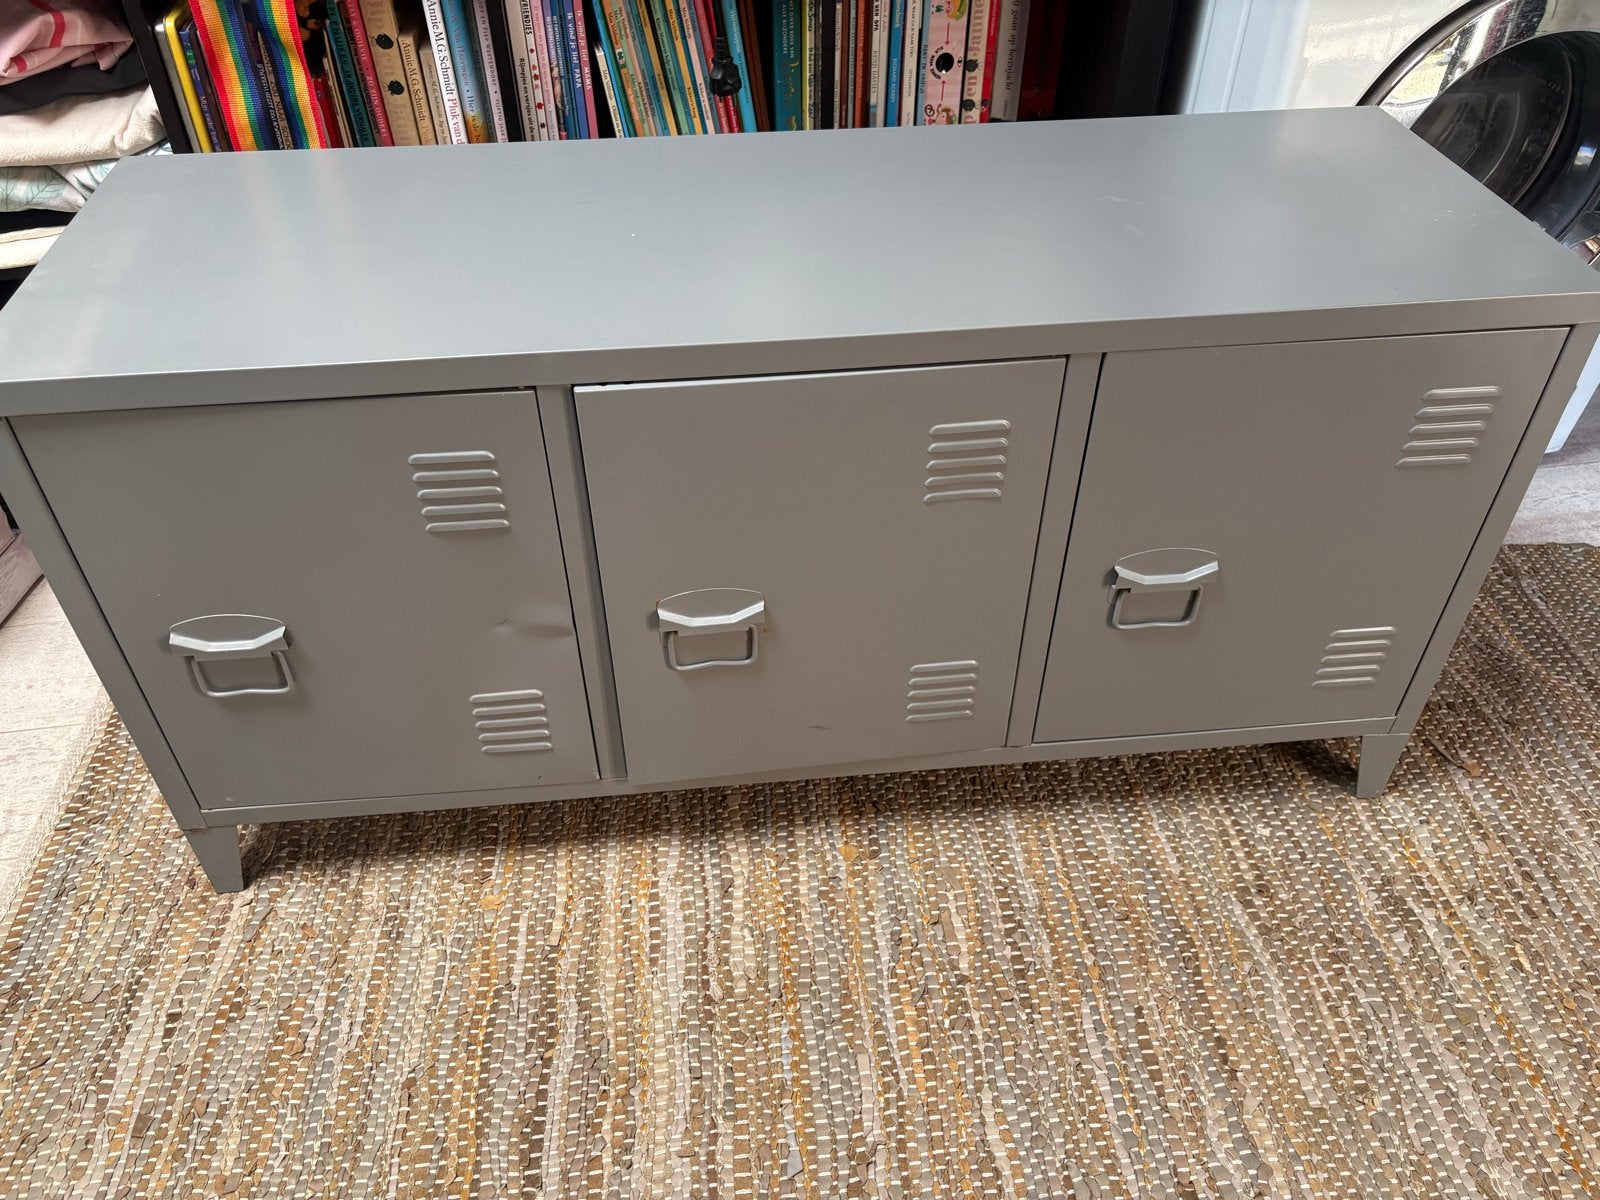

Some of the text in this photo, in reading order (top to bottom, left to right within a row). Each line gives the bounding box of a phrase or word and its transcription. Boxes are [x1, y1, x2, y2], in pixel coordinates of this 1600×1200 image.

[426, 0, 442, 29] Annie
[1009, 9, 1020, 31] gaan
[567, 23, 575, 39] vind
[1008, 34, 1018, 45] op
[432, 30, 448, 54] M.G.
[570, 41, 577, 49] je
[402, 42, 415, 67] Annie
[571, 51, 579, 63] lief
[577, 20, 585, 37] vind
[583, 66, 592, 90] MAMA
[407, 67, 420, 88] M.G.
[438, 56, 456, 94] Schmidt
[518, 58, 529, 85] Rijmpjes
[573, 69, 582, 88] PAPA
[601, 69, 609, 80] Max
[1003, 48, 1016, 90] berenjacht
[366, 75, 375, 86] ZO
[522, 86, 530, 94] en
[966, 75, 978, 97] en
[369, 88, 380, 104] ZIJN
[412, 89, 427, 121] Schmidt
[523, 95, 533, 116] versjes
[274, 101, 285, 121] NAAR
[447, 98, 461, 120] Pluk
[466, 95, 476, 112] Hier
[472, 124, 481, 132] de
[374, 107, 388, 137] OUDERS
[452, 121, 465, 137] van
